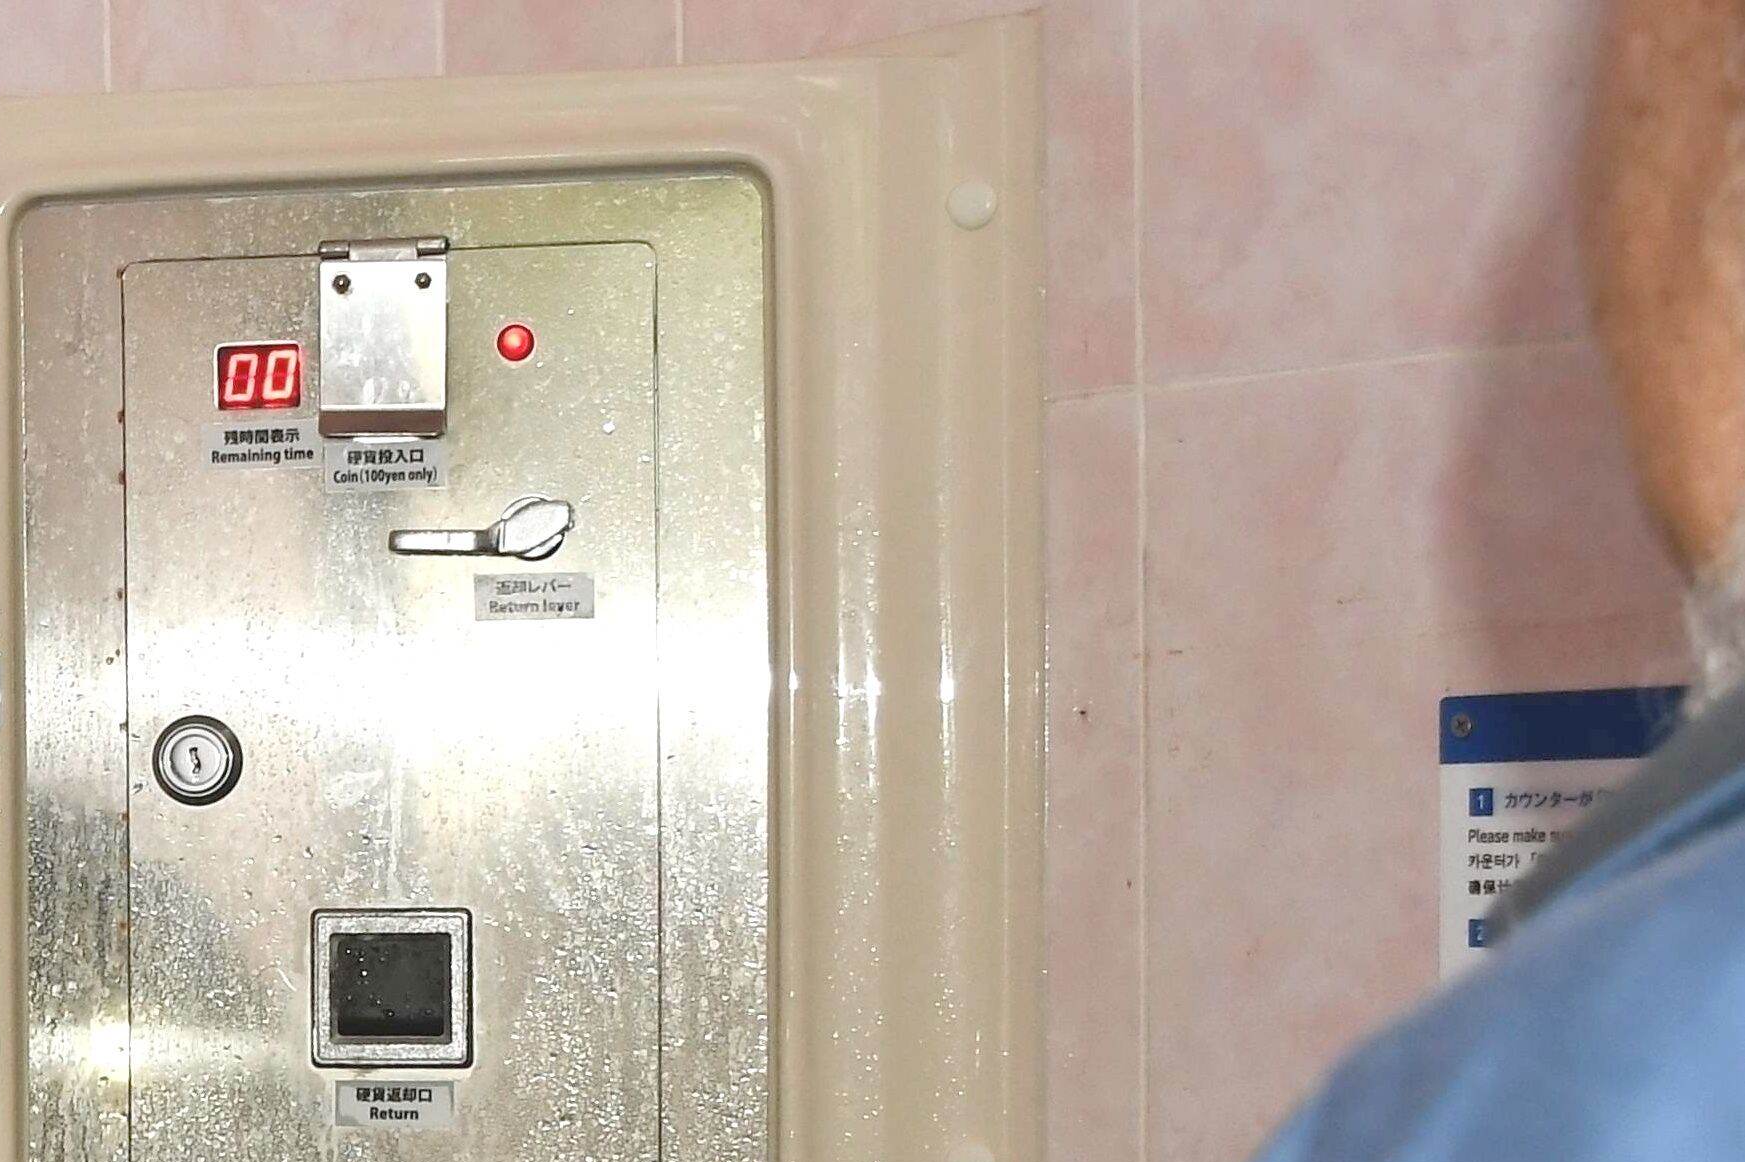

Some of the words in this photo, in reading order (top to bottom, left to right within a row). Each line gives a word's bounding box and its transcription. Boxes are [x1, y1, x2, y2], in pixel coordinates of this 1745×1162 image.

[223, 349, 298, 403] 00
[224, 428, 301, 445] 残時間表示
[211, 447, 281, 465] Remaining
[283, 446, 314, 461] time
[408, 466, 438, 482] only)
[489, 600, 539, 613] Return
[542, 599, 580, 613] lever
[1468, 828, 1509, 844] Please
[1513, 828, 1546, 843] make
[355, 1086, 433, 1103] 硬貨返却口
[369, 1107, 420, 1121] Return
